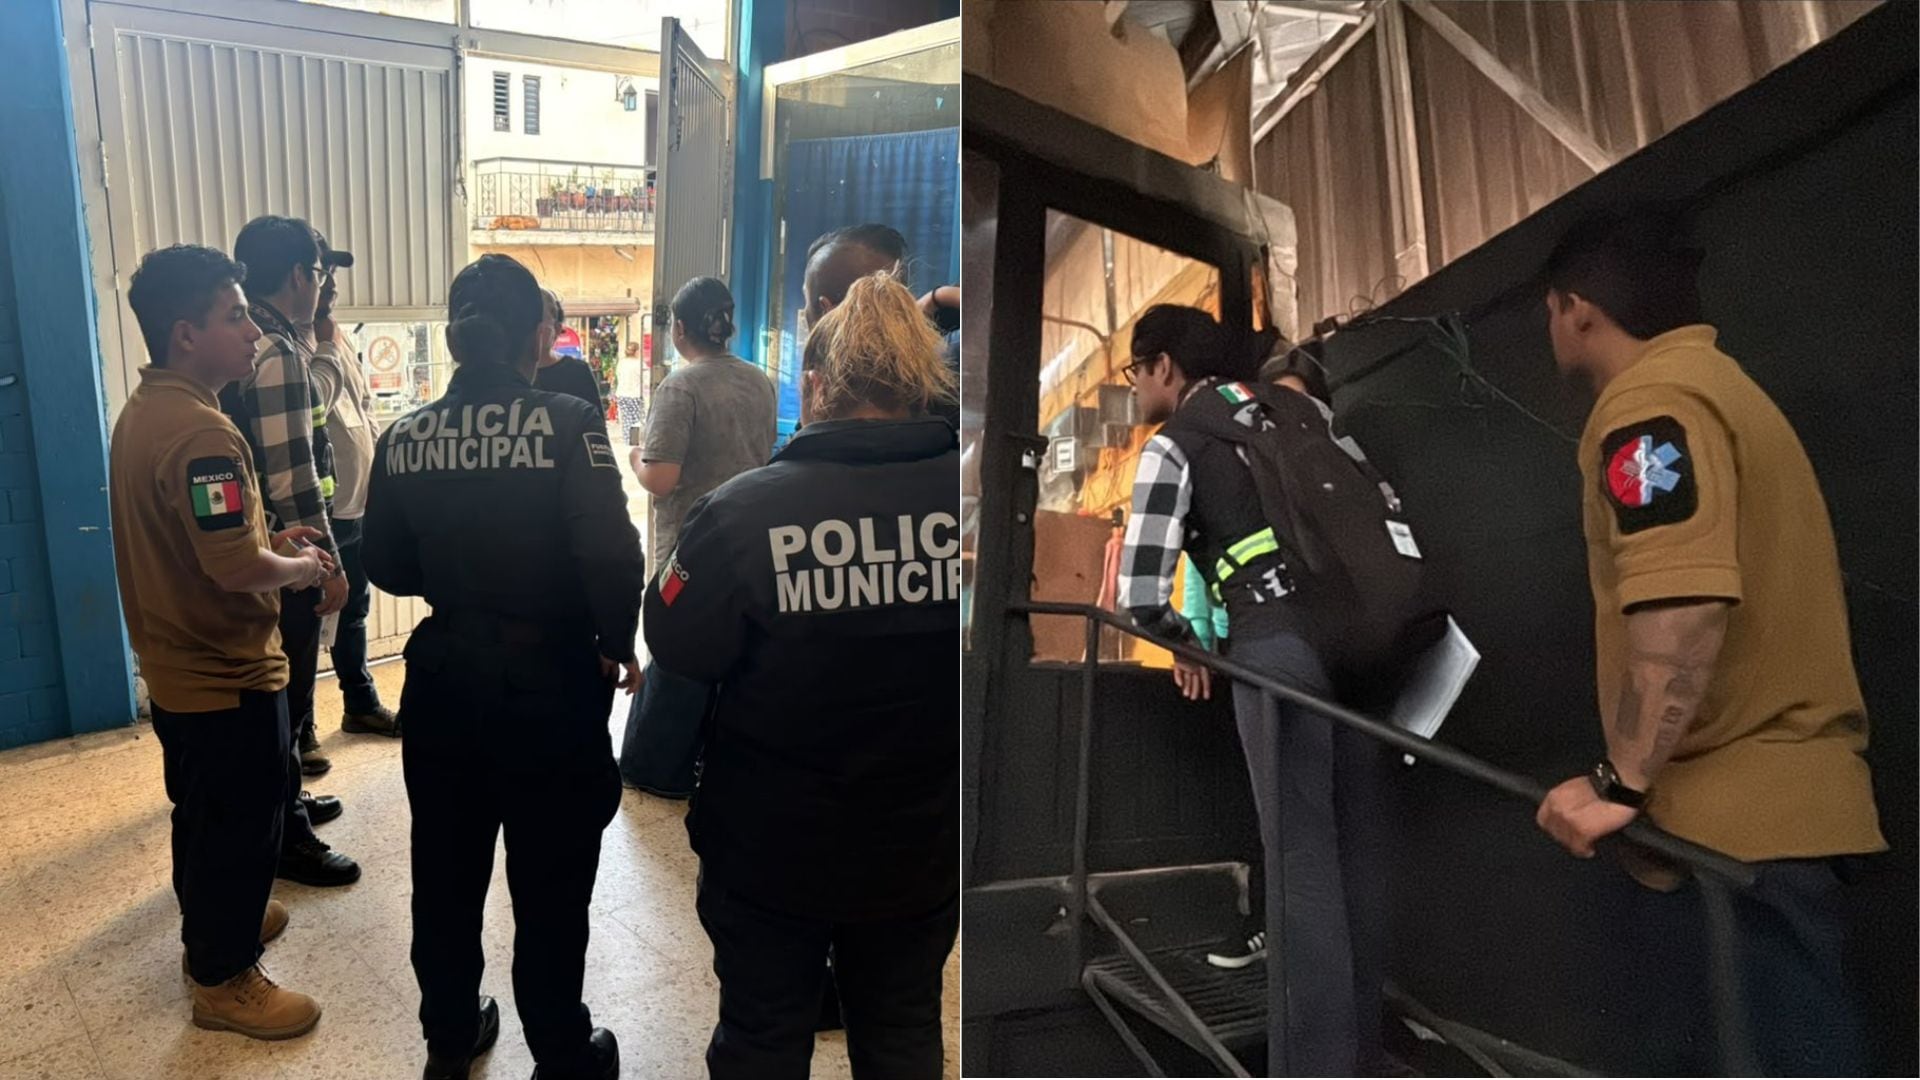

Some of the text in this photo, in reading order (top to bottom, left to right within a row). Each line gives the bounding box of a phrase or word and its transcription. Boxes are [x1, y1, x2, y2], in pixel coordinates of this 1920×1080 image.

[388, 399, 554, 445] POLICÍA
[386, 436, 555, 476] MUNICIPAL
[193, 472, 234, 484] MEXICO
